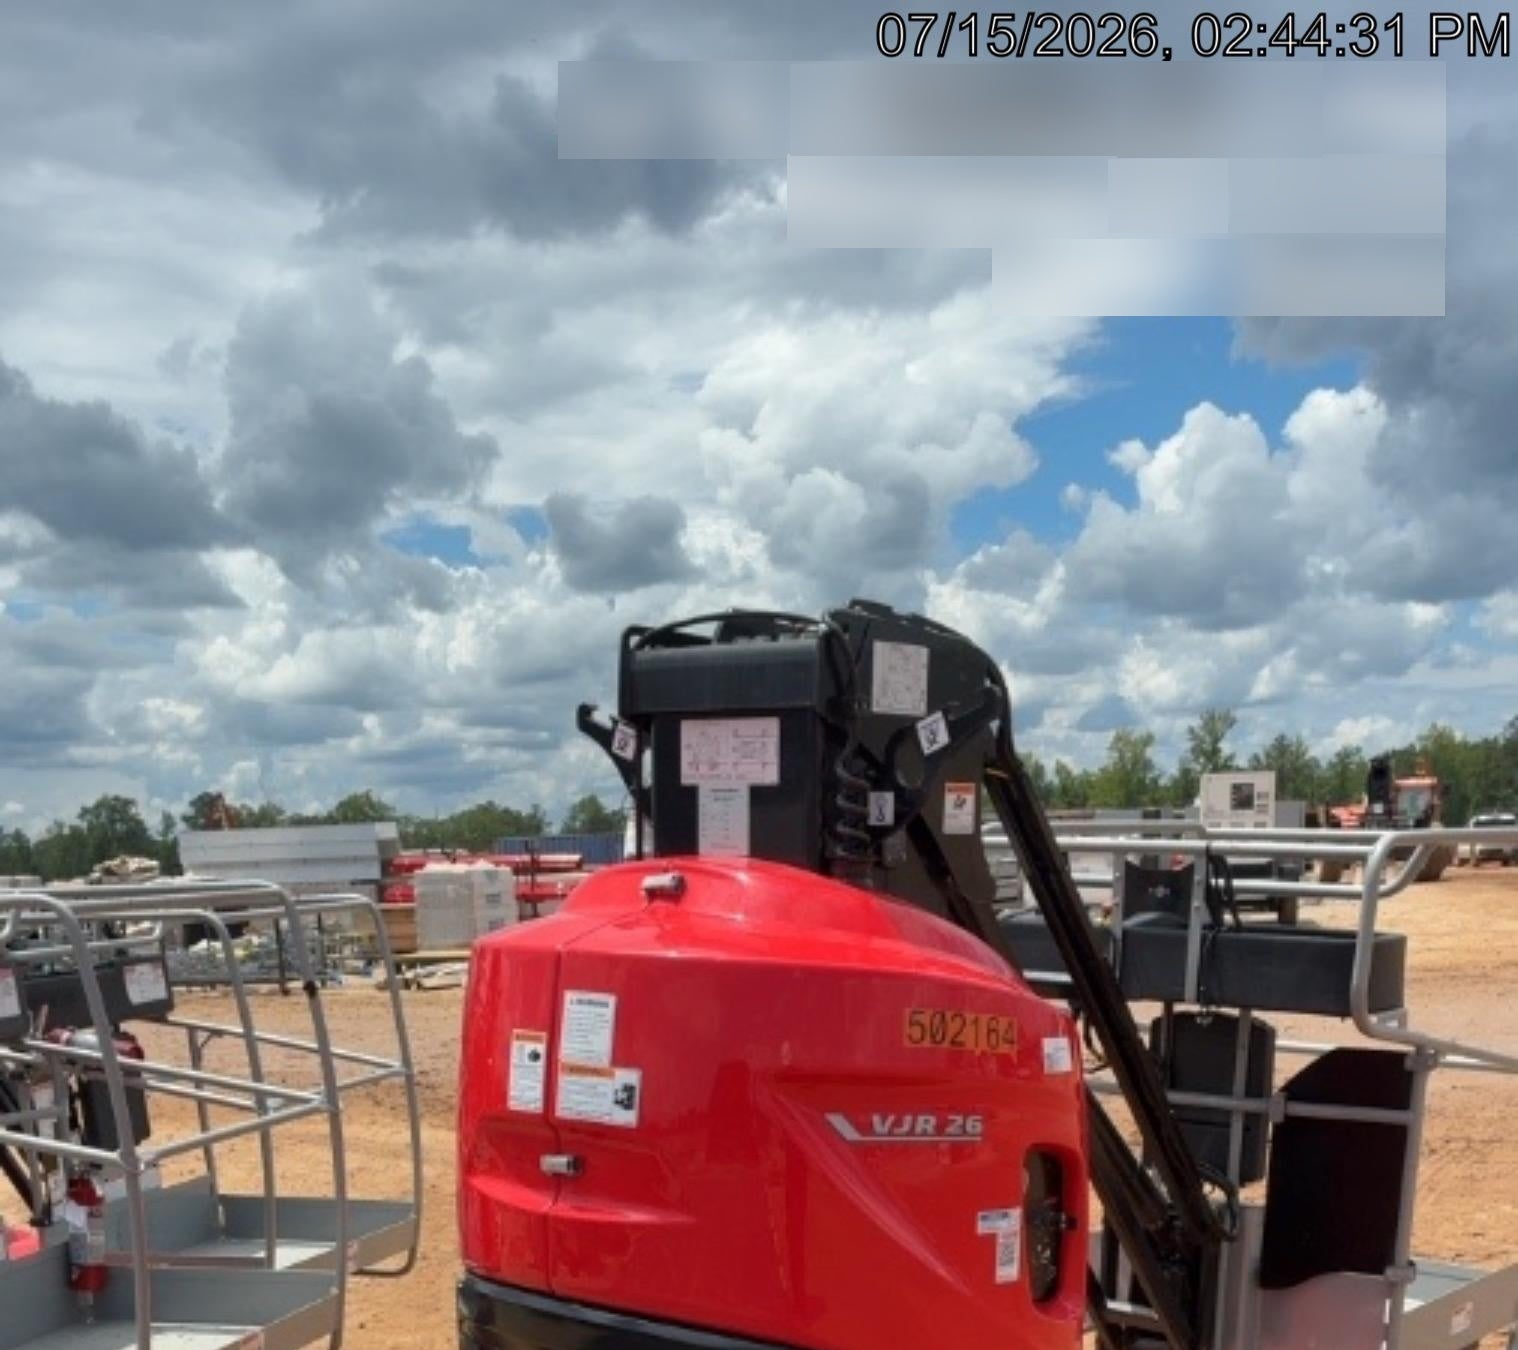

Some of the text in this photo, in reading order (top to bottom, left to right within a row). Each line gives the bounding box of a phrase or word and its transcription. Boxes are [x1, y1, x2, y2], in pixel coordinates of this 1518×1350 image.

[907, 1010, 1016, 1050] 502164
[872, 1114, 983, 1136] VJR 26
